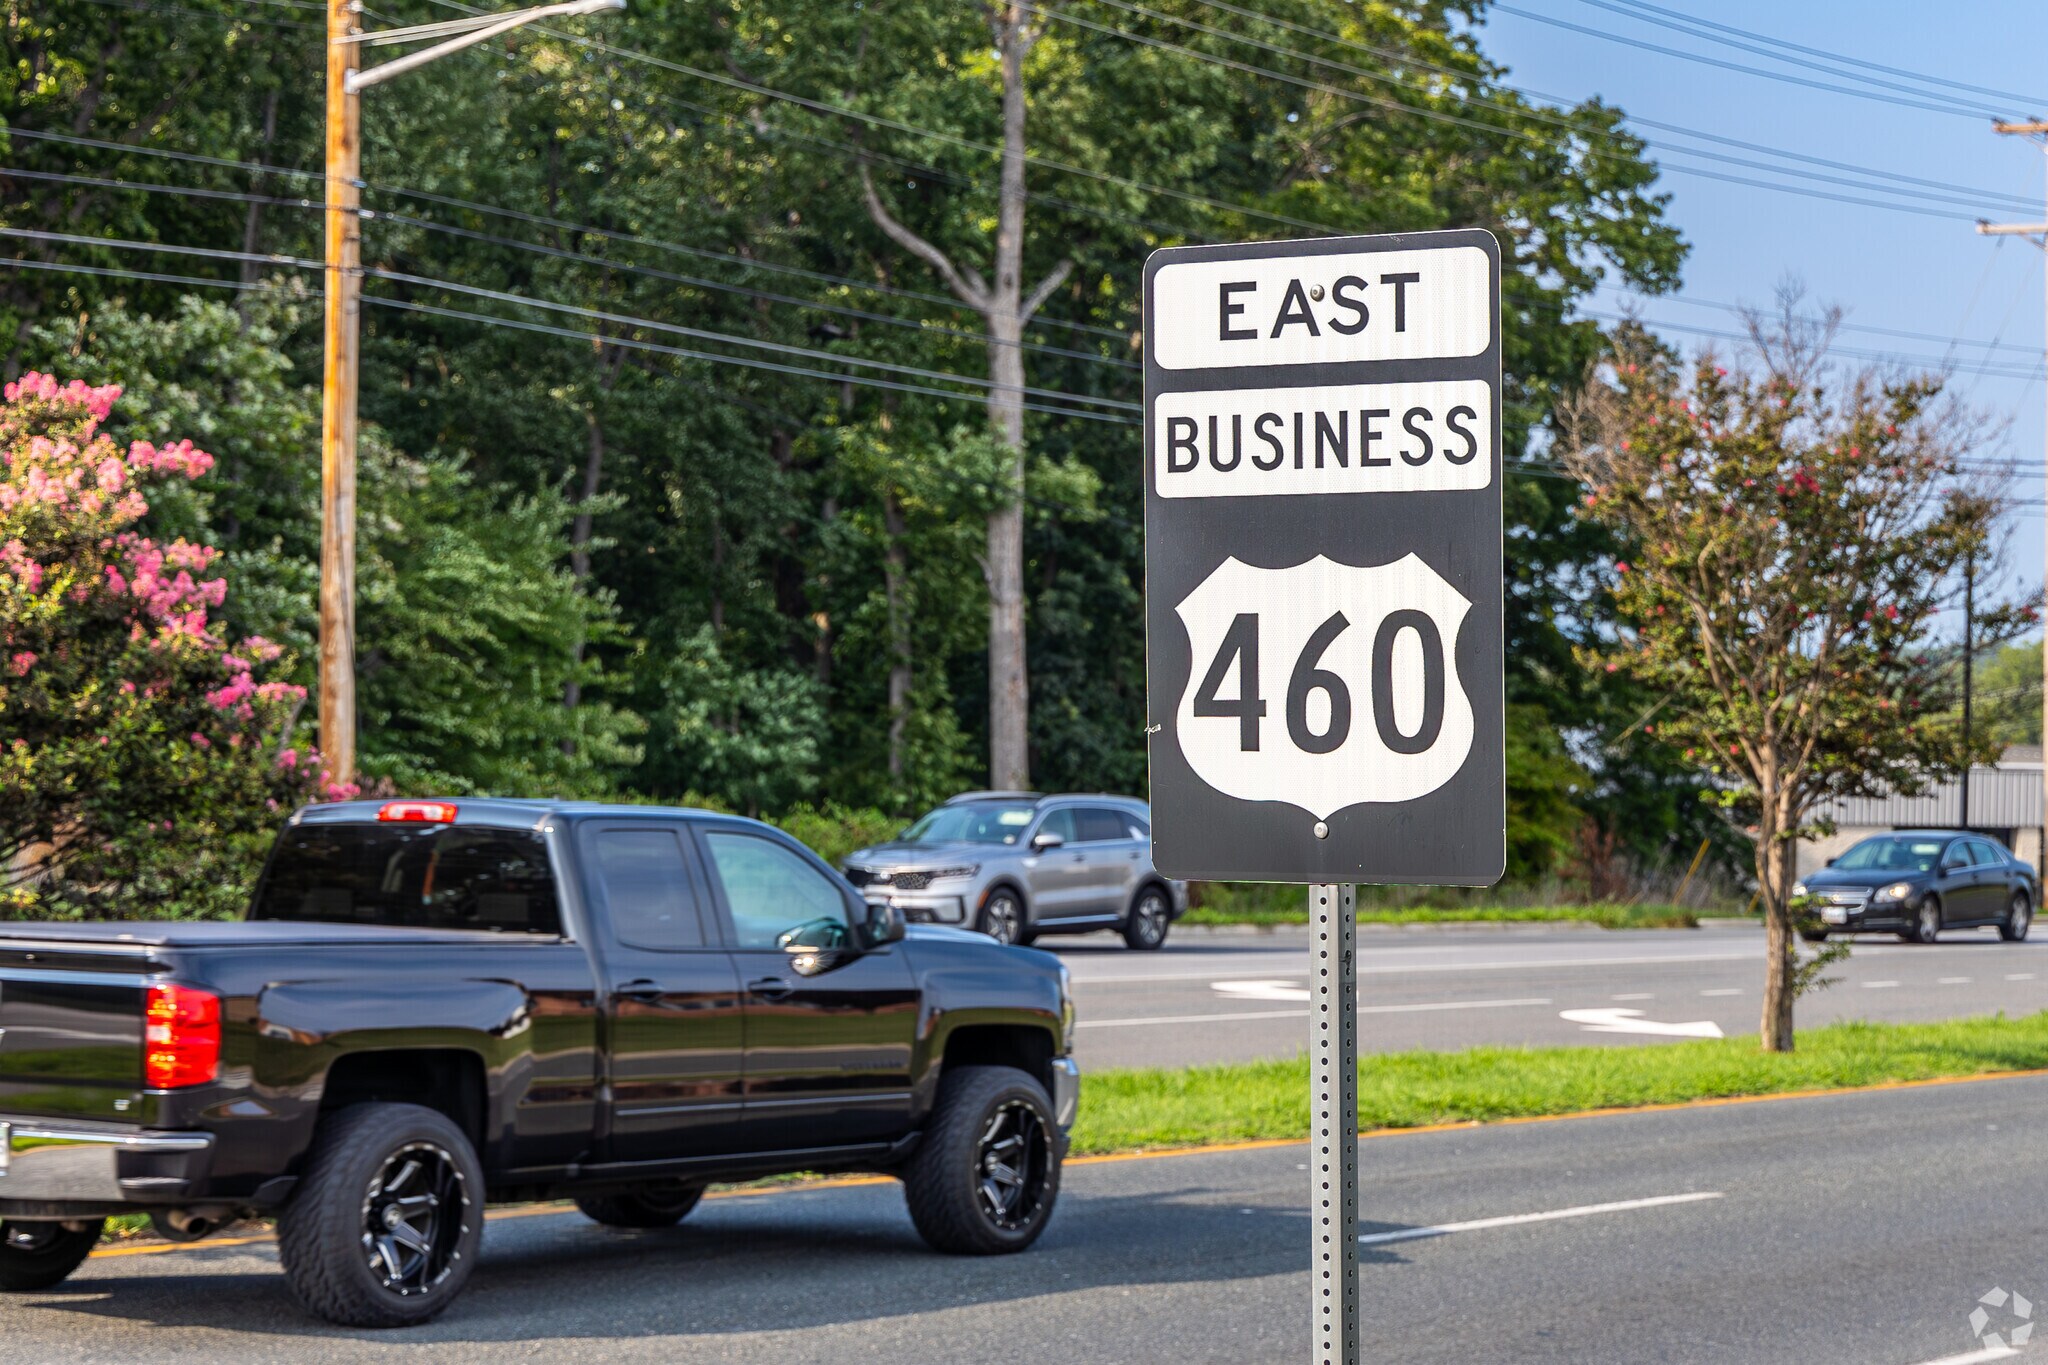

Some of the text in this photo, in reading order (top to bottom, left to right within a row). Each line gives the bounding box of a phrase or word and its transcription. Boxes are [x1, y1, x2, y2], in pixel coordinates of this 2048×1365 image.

[1220, 272, 1420, 341] EAST
[1167, 405, 1477, 473] BUSINESS
[1193, 609, 1446, 755] 460
